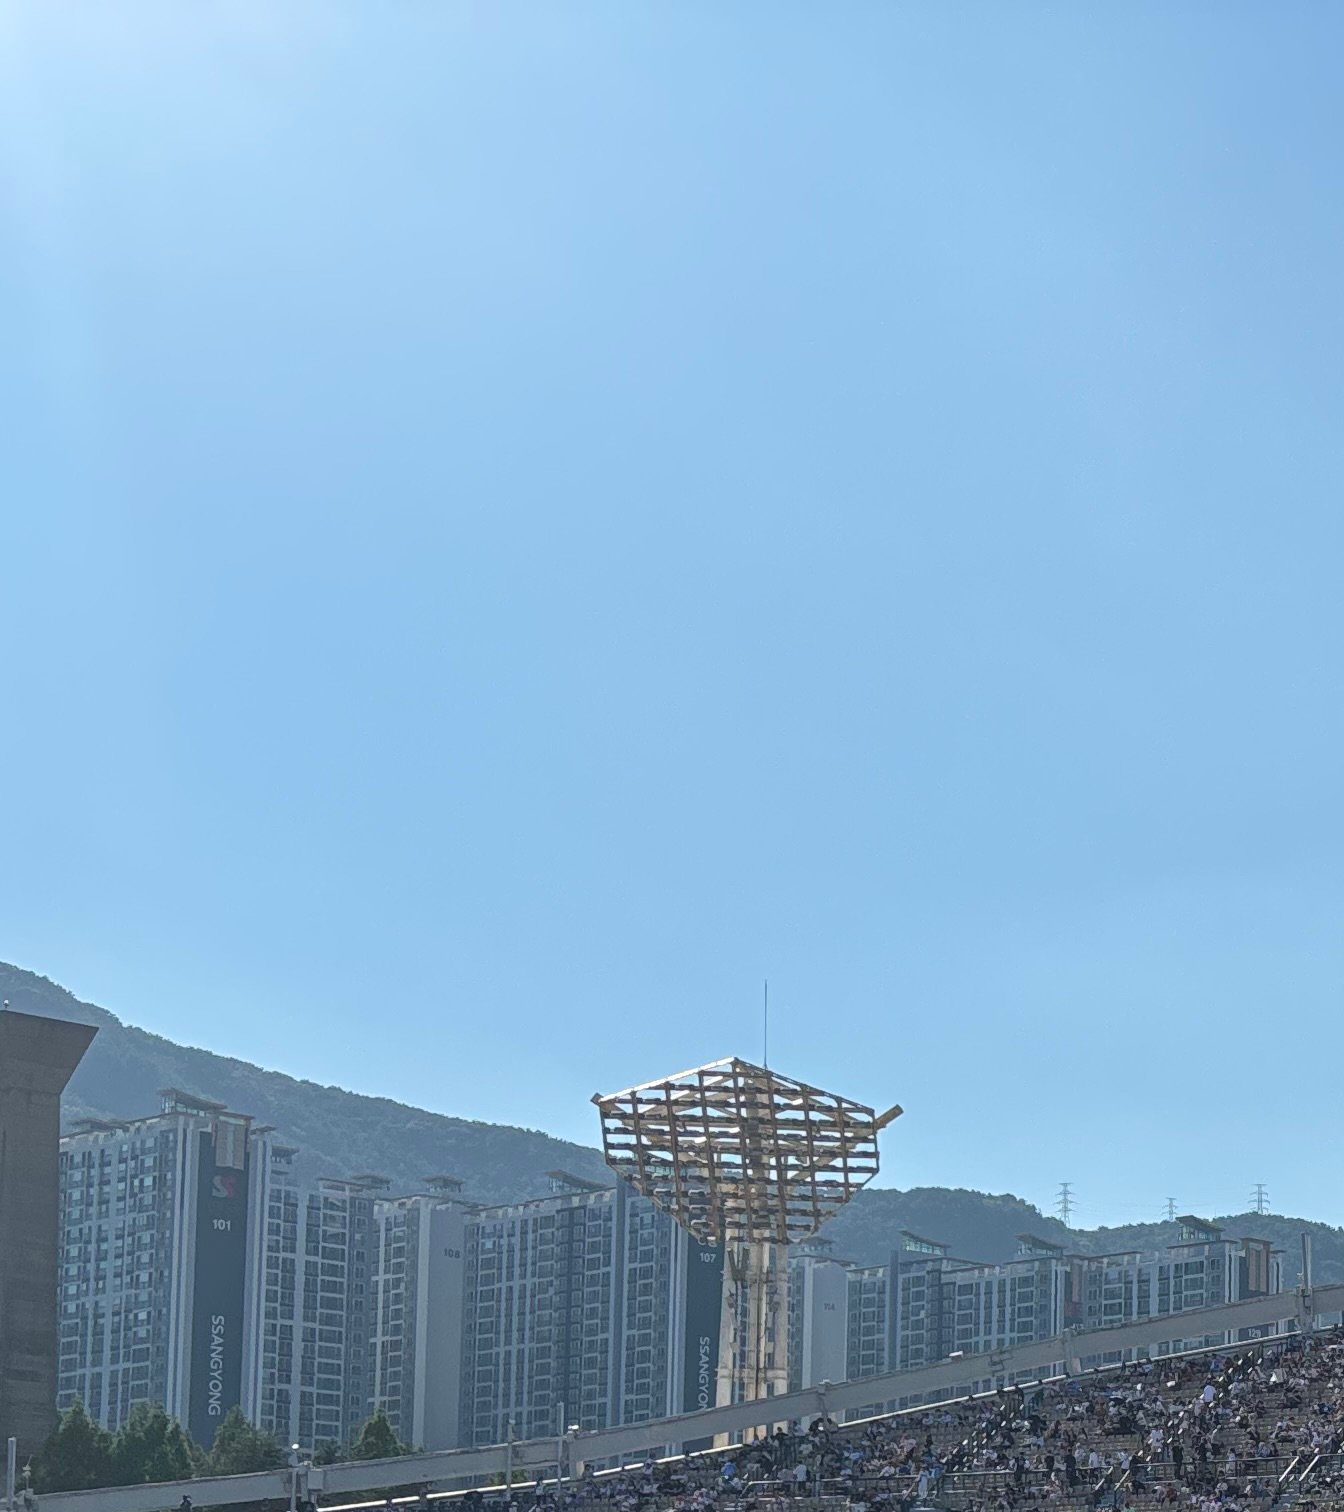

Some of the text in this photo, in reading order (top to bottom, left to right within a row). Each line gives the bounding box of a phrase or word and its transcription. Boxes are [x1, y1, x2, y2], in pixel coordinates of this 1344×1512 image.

[212, 1218, 231, 1231] 101
[700, 1252, 717, 1264] 107
[207, 1315, 225, 1417] SSANGYONG
